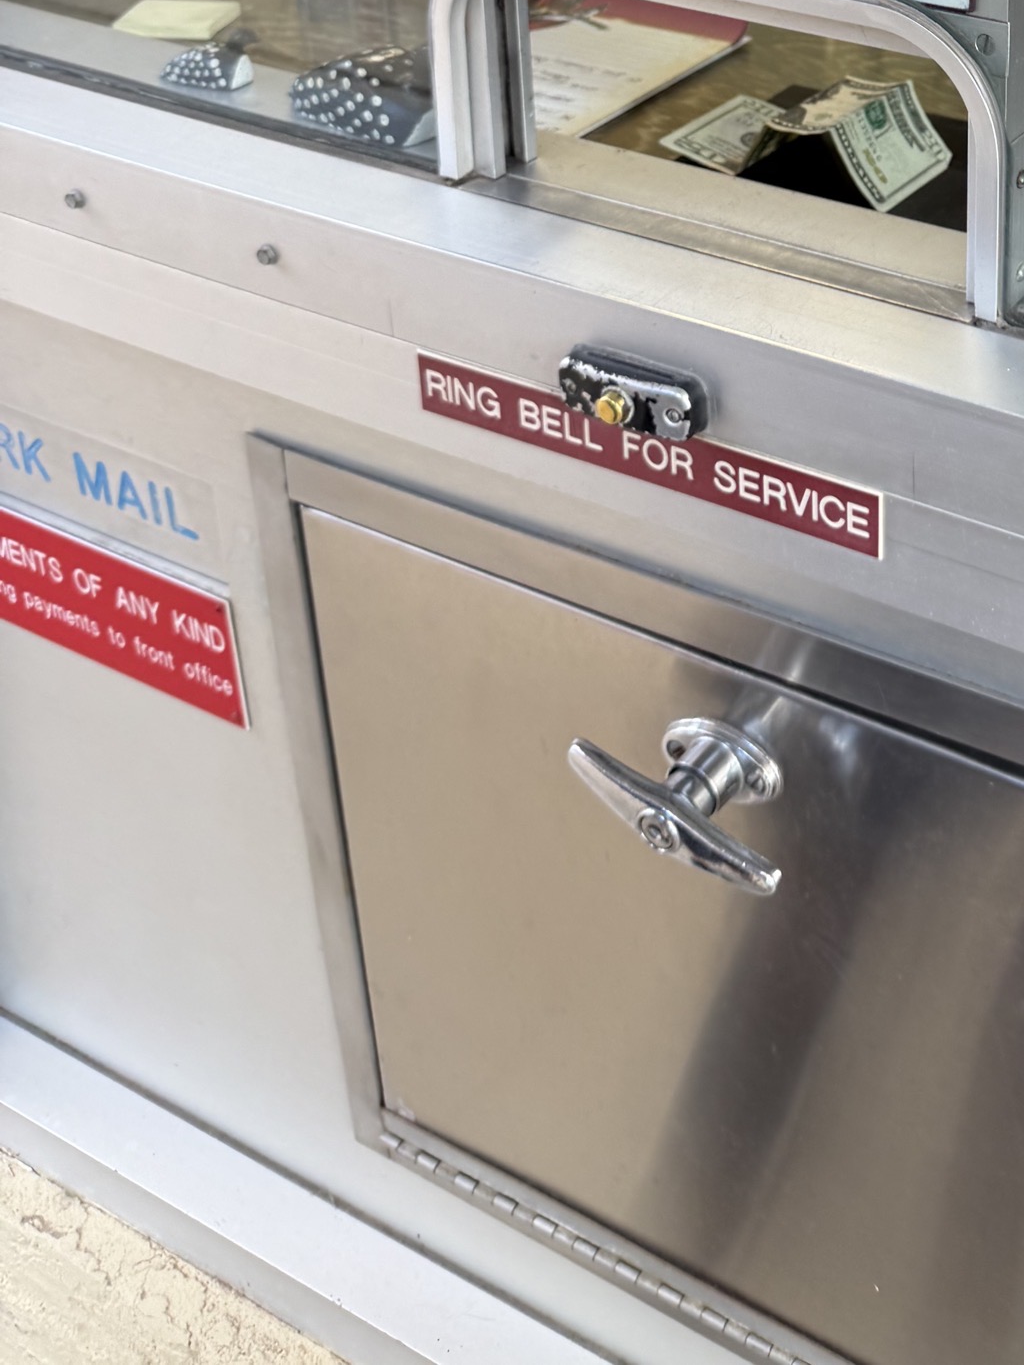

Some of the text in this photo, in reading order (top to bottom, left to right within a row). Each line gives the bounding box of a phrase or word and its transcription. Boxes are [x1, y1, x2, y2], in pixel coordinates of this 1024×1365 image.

[72, 451, 200, 541] MAIL
[425, 369, 870, 539] RING BELL FOR SERVICE
[23, 590, 101, 638] payments
[107, 626, 127, 650] to
[134, 636, 176, 671] front
[184, 662, 234, 697] office
[72, 567, 103, 598] OF
[115, 586, 160, 625] ANY
[171, 609, 226, 654] KIND
